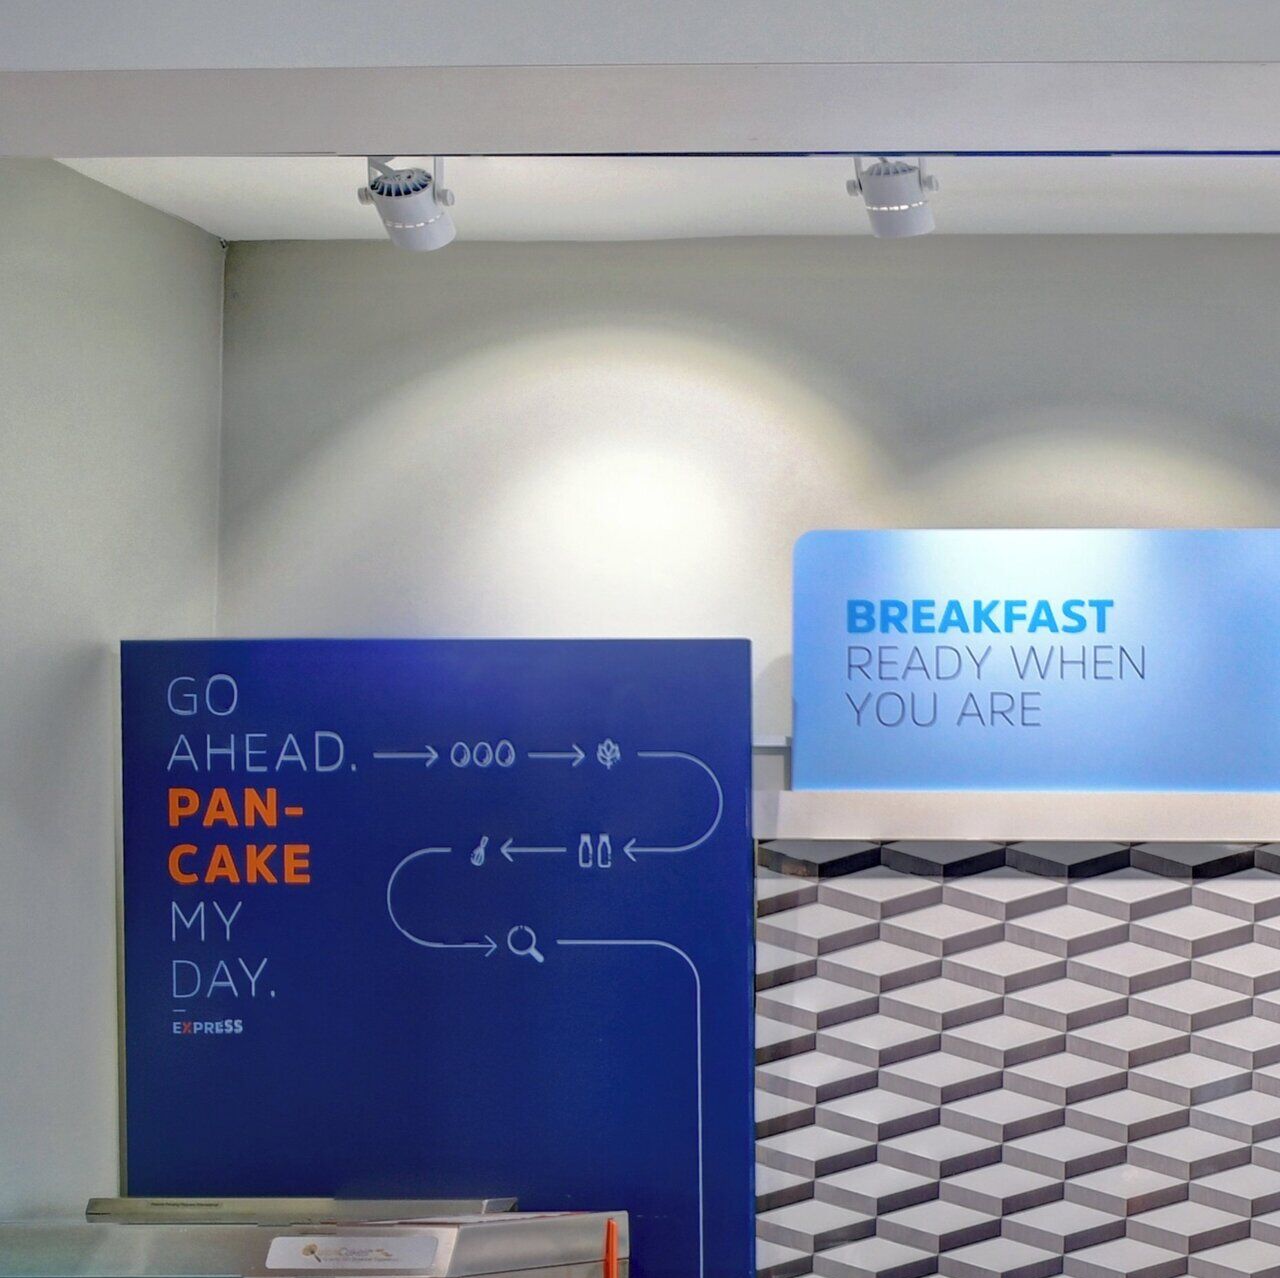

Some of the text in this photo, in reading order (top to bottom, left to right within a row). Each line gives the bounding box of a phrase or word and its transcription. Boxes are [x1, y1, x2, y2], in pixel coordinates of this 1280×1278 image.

[846, 598, 1116, 634] BREAKFAST
[846, 644, 1147, 682] READY WHEN
[167, 673, 239, 717] GO
[845, 690, 1043, 728] YOU ARE
[167, 730, 357, 772] AHEAD.
[168, 787, 304, 829] PAN-
[168, 843, 311, 885] CAKE
[171, 901, 243, 942] MY
[171, 957, 277, 999] DAY.
[172, 1018, 244, 1035] EXPRESS
